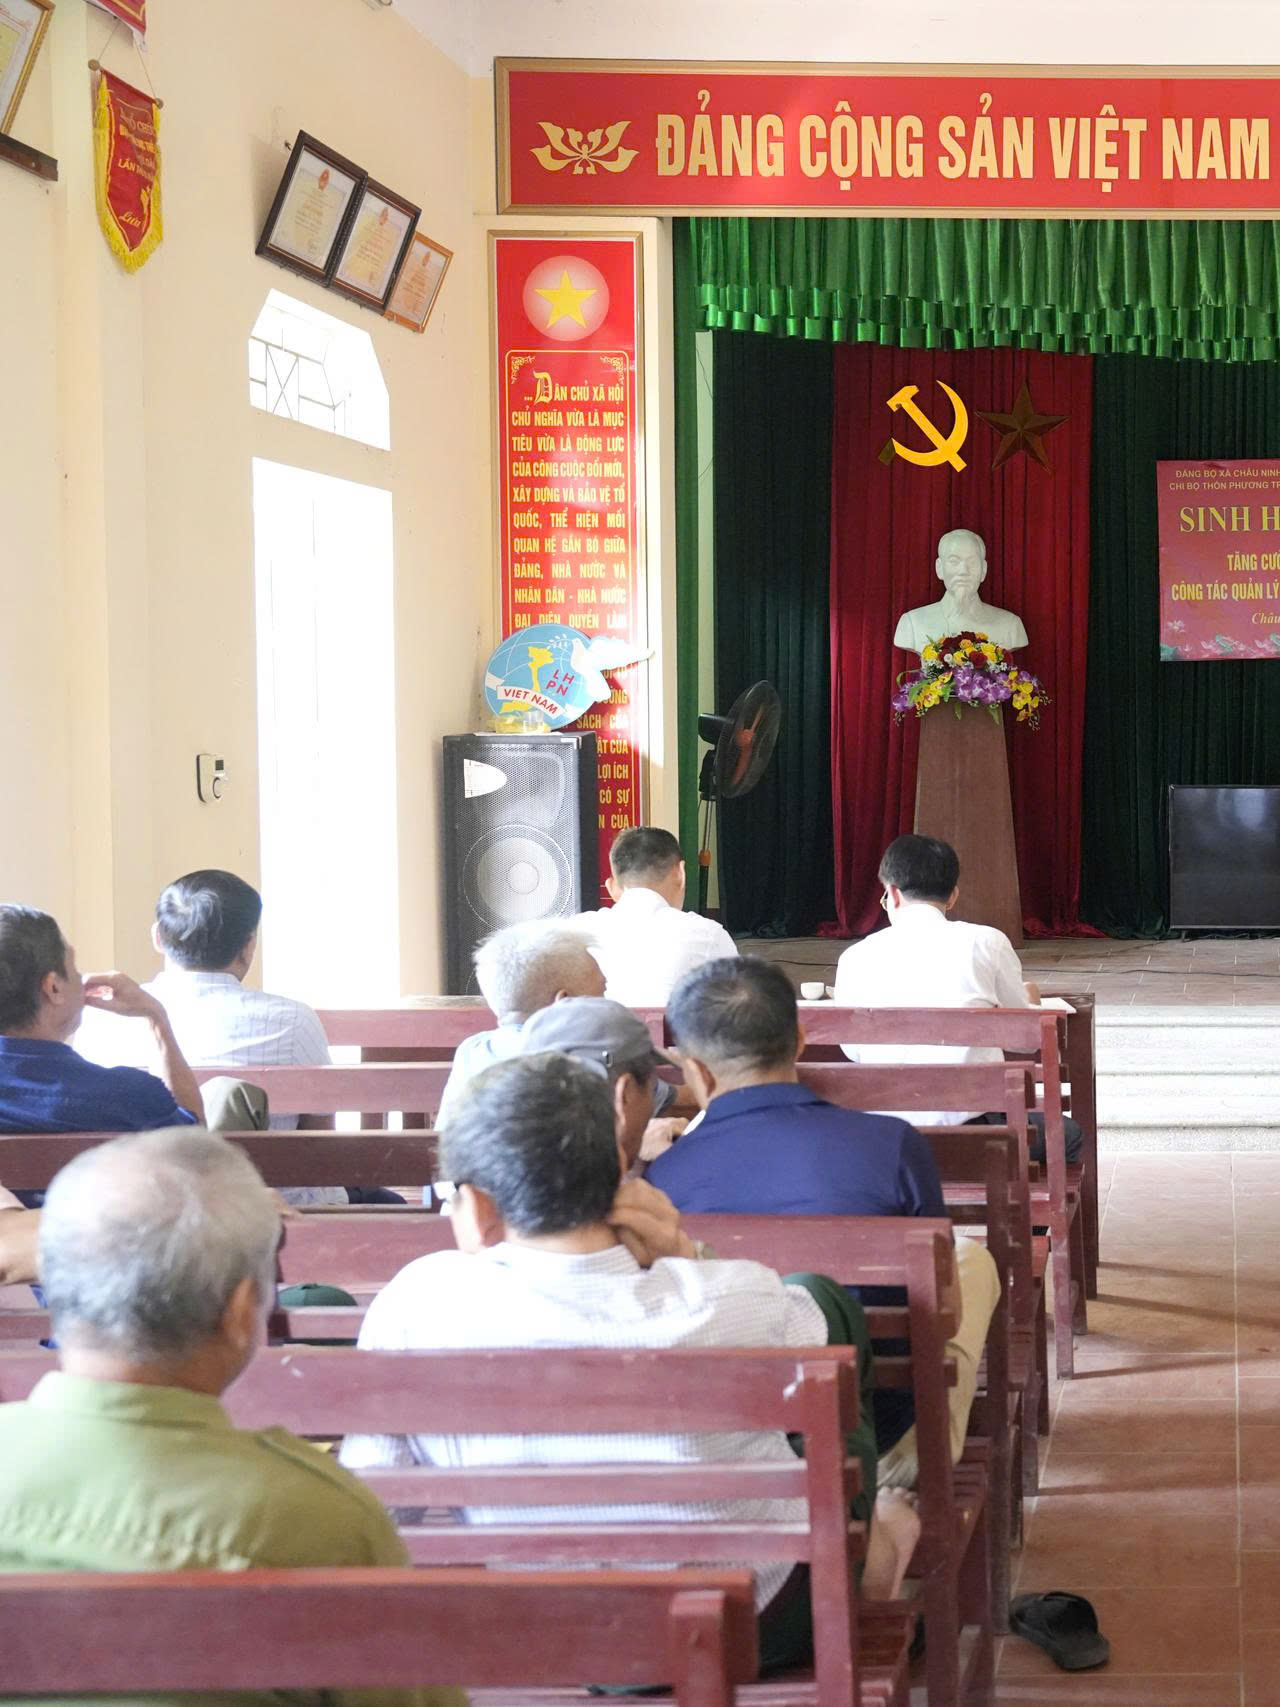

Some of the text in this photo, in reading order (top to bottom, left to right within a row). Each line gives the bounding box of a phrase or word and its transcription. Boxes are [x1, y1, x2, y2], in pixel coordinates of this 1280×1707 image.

[655, 89, 784, 178] ĐẢNG
[800, 101, 925, 190] CỘNG
[938, 92, 1034, 179] SẢN
[1049, 105, 1148, 192] VIỆT
[1161, 117, 1270, 180] NAM
[570, 380, 589, 401] CHỦ
[592, 383, 605, 401] XÃ
[608, 382, 624, 405] HỘI
[512, 406, 624, 430] CHỦ NGHĨA VỪA LÀ MỤC
[512, 433, 624, 455] TIÊU VỪA LÀ ĐỘNG LỰC
[1169, 481, 1269, 491] CHI BỘ THÔN PHƯƠNG
[1179, 506, 1250, 533] SINH
[1227, 551, 1257, 571] TĂNG
[1171, 580, 1203, 600] CÔNG
[1206, 580, 1228, 600] TÁC
[1232, 578, 1263, 601] QUẢN
[1267, 579, 1279, 599] LÝ
[1251, 612, 1280, 625] Châu
[610, 733, 628, 754] CỦA
[598, 761, 629, 782] LỢI ÍCH
[599, 787, 630, 807] CÓ SỰ
